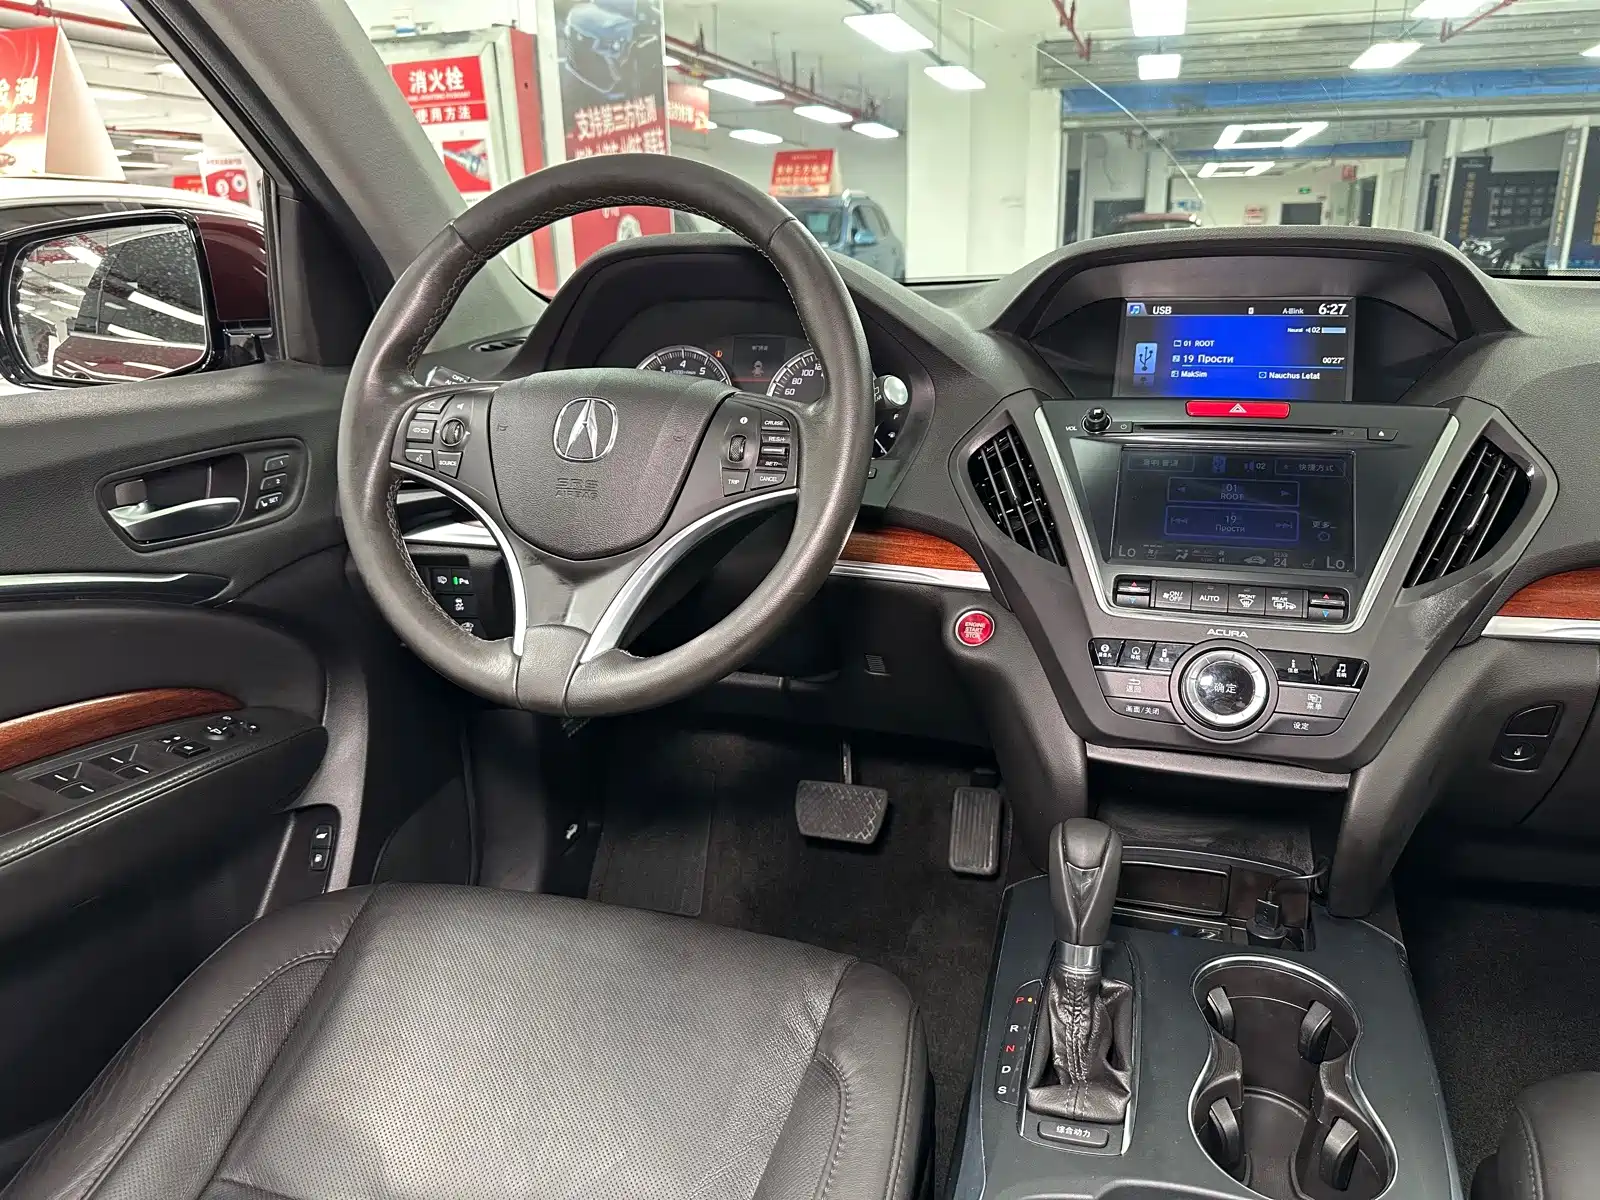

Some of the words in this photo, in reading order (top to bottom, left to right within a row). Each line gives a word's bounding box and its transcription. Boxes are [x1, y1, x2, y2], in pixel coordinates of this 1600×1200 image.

[408, 66, 465, 94] 消火栓
[415, 104, 471, 124] 使用方法
[1152, 305, 1172, 315] USB
[1318, 303, 1347, 315] 6:27
[1311, 326, 1321, 334] 02
[1183, 340, 1192, 348] 01
[1194, 340, 1215, 348] ROOT
[1183, 354, 1195, 363] 19
[1197, 354, 1234, 364] Прости
[679, 360, 687, 368] 4
[699, 366, 706, 376] 5
[801, 369, 815, 377] 100
[1180, 370, 1208, 378] MakSim
[1268, 371, 1300, 379] Nauchus
[791, 377, 803, 385] 80
[784, 388, 796, 396] 60
[1255, 462, 1266, 470] 02
[1225, 483, 1238, 492] 01
[1225, 515, 1237, 525] 19
[1215, 523, 1246, 532] Прости
[1118, 544, 1136, 558] Lo
[1273, 557, 1287, 567] 24
[1326, 555, 1345, 570] Lo
[1199, 594, 1220, 602] AUTO
[1206, 628, 1248, 639] ACURA
[1126, 685, 1142, 693] 返回
[1214, 682, 1237, 694] 确定
[1292, 721, 1310, 731] 设定
[1015, 996, 1024, 1004] P
[1009, 1024, 1019, 1032] R
[1005, 1044, 1016, 1053] N
[1001, 1065, 1011, 1074] D
[997, 1086, 1007, 1095] S
[1056, 1124, 1091, 1138] 综合动力
